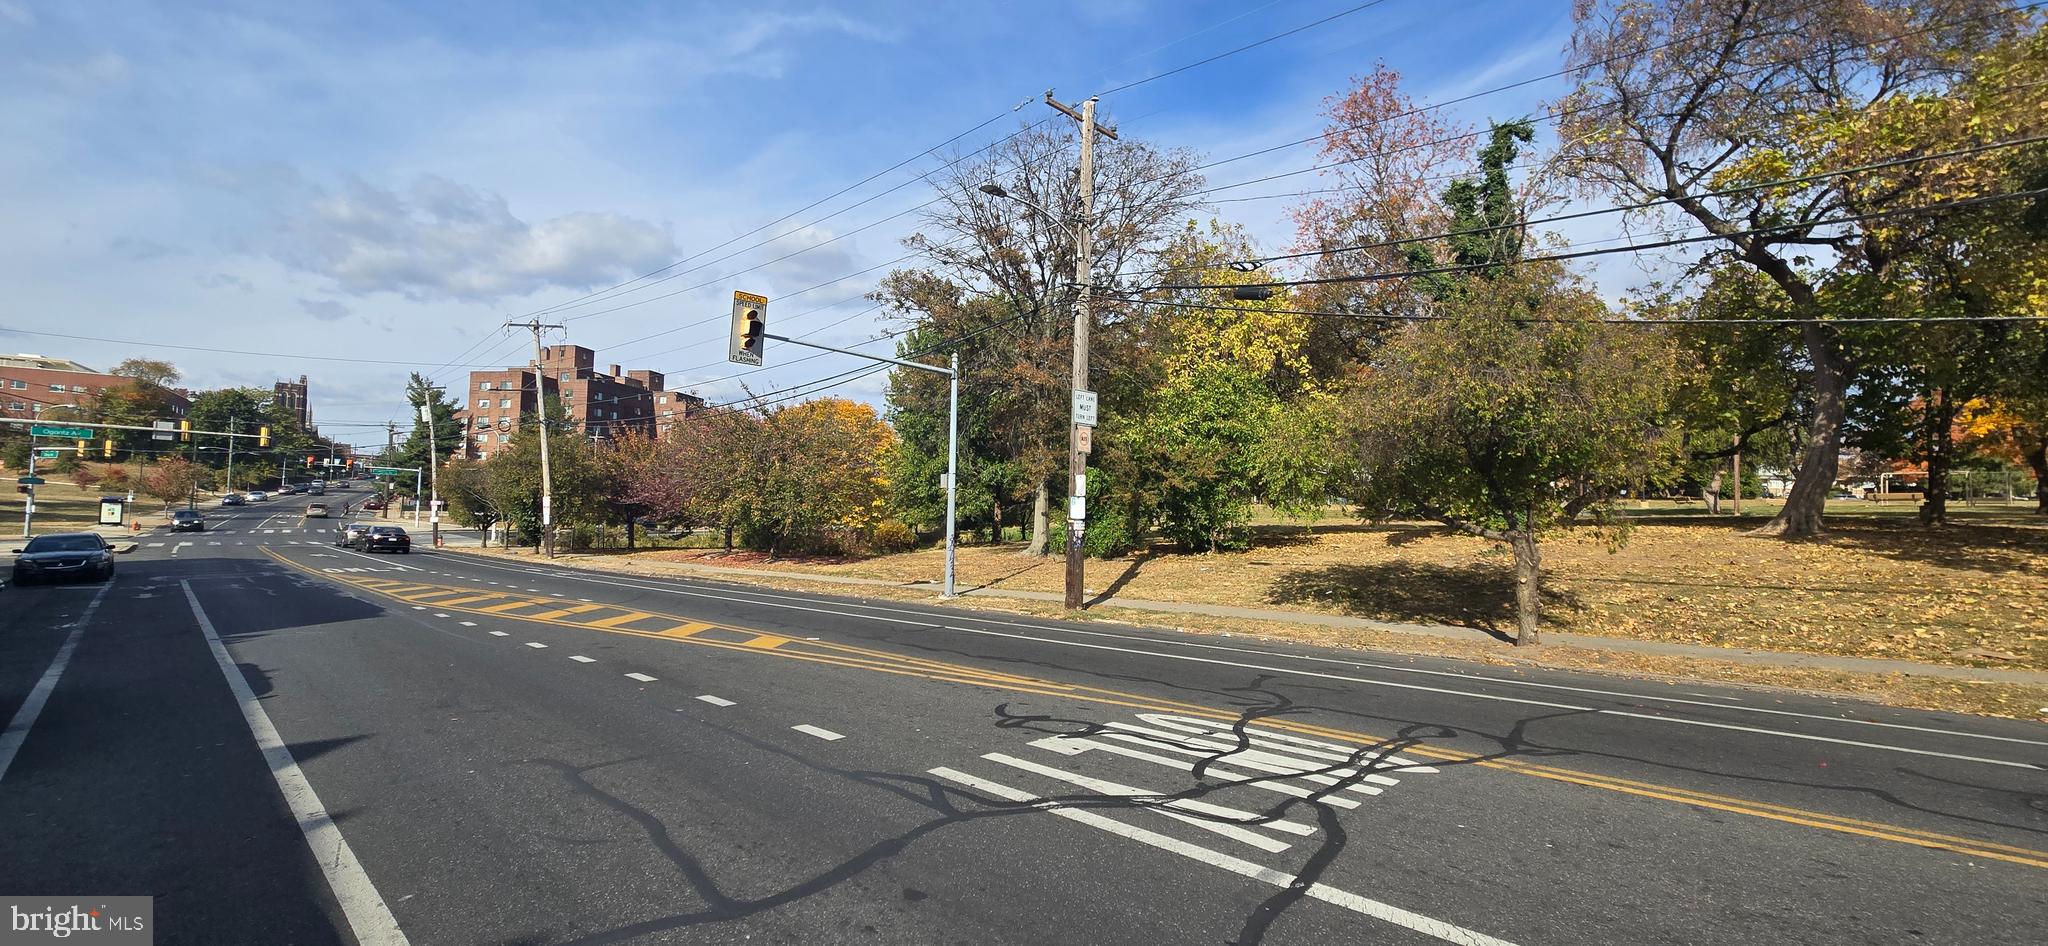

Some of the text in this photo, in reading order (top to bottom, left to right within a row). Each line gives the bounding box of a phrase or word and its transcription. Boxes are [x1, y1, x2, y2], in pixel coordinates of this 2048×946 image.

[738, 293, 763, 303] SCHOOL
[736, 300, 764, 311] SPEED LIMIT
[738, 350, 754, 358] WHEN
[732, 355, 759, 365] FLASHING
[1079, 403, 1092, 412] MUST
